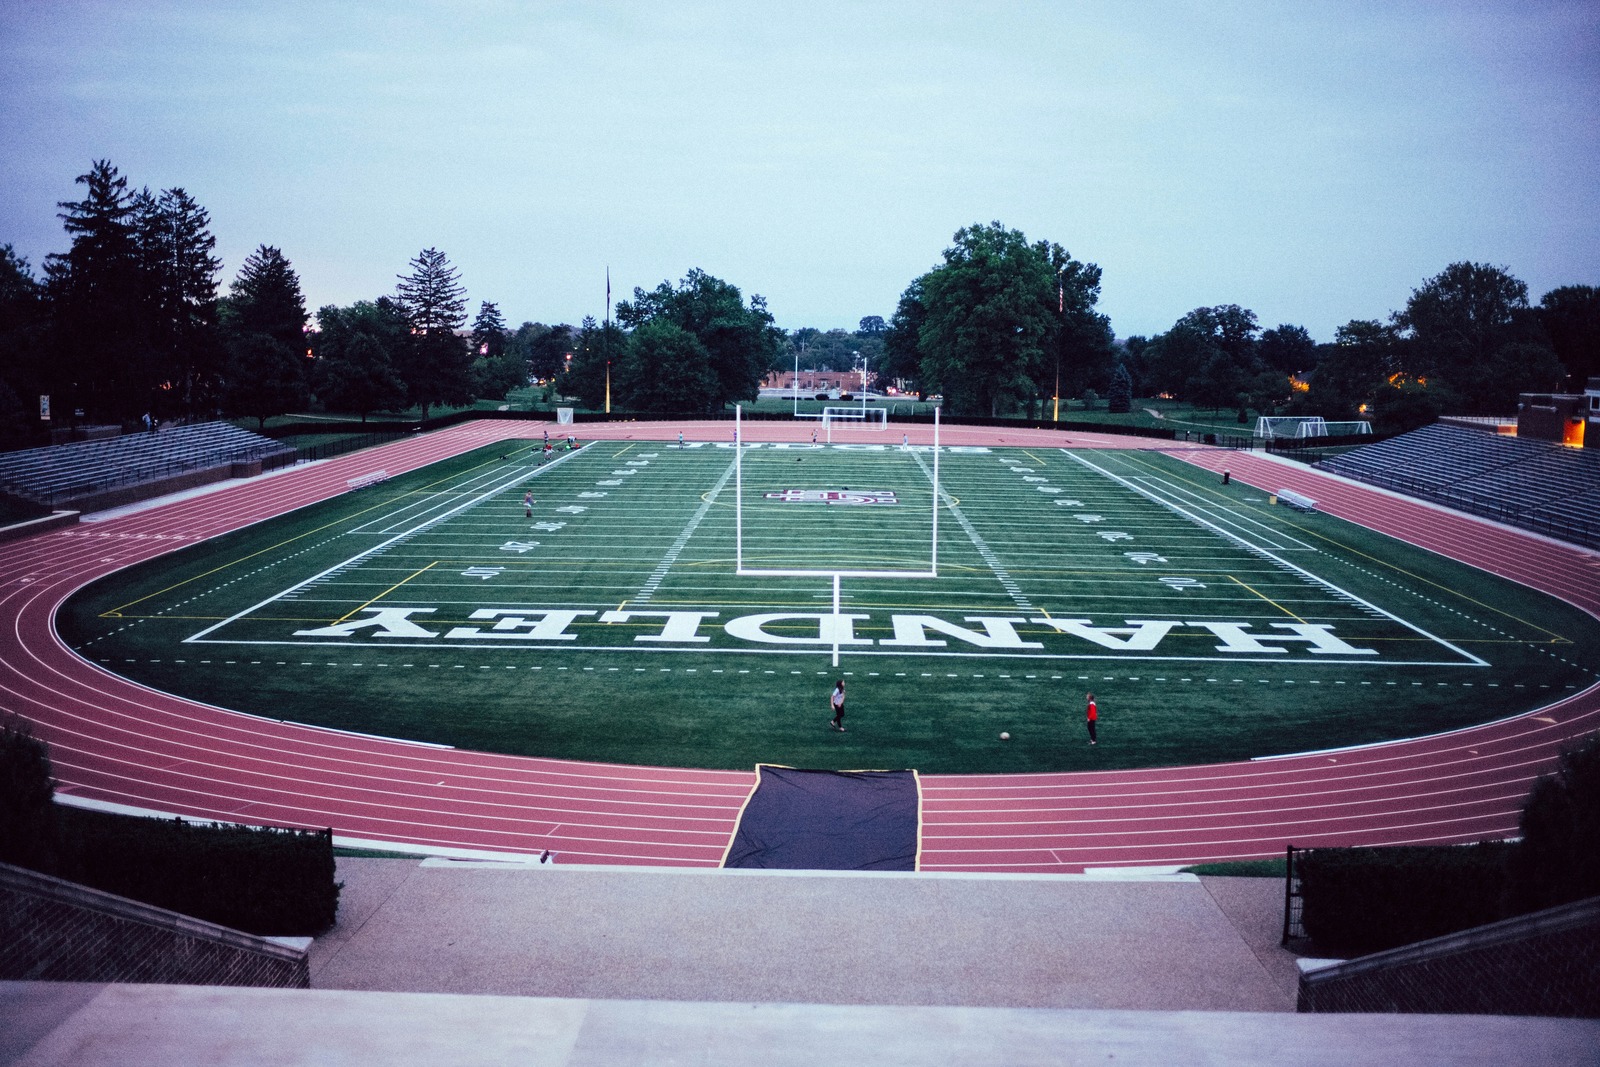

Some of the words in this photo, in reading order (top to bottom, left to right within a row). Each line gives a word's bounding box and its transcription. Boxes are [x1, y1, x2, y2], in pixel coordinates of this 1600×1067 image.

[461, 566, 506, 577] 10
[1158, 577, 1207, 588] 10
[291, 607, 1380, 655] HANDLEY
